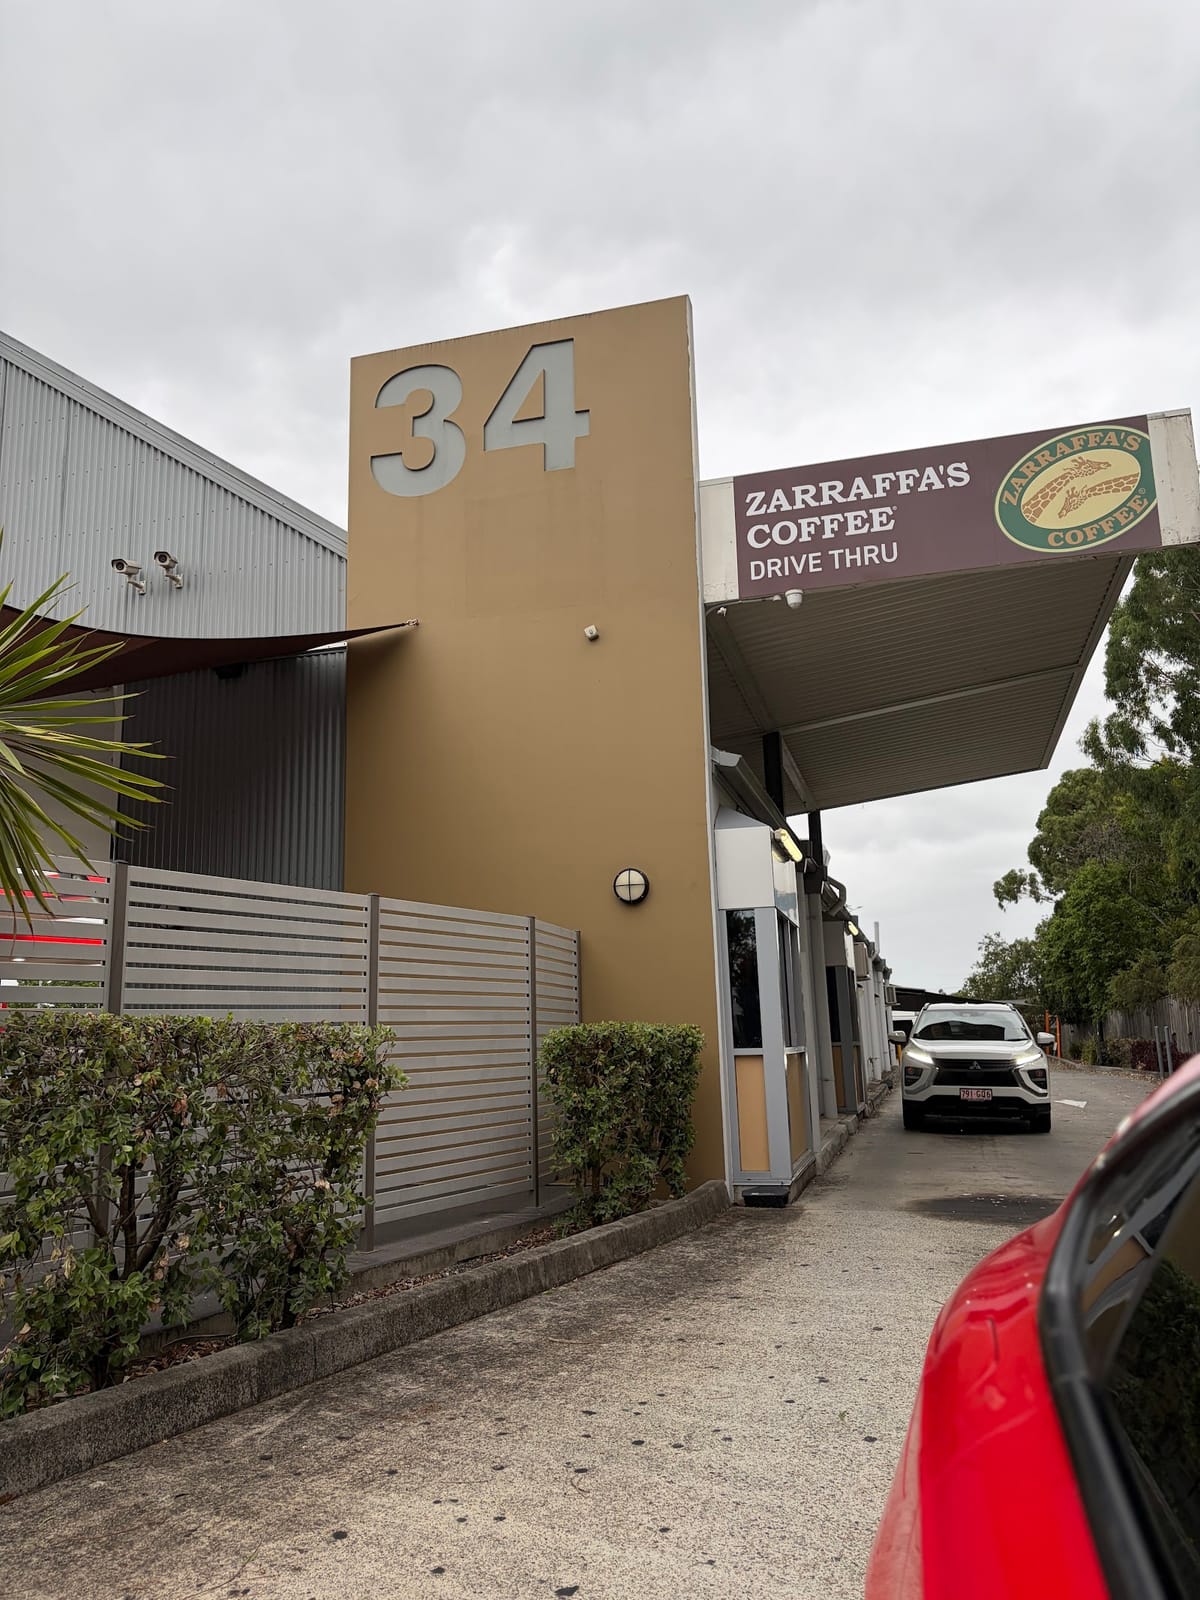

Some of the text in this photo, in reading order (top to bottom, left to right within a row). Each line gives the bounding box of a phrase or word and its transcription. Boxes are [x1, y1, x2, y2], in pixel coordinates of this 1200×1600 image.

[369, 337, 590, 498] 34
[745, 461, 971, 517] ZARRAFFA'S
[1002, 431, 1142, 507] ZARRAFFA'S
[746, 506, 896, 549] COFFEE
[1047, 495, 1149, 547] COFFEE
[749, 542, 898, 581] DRIVE THRU
